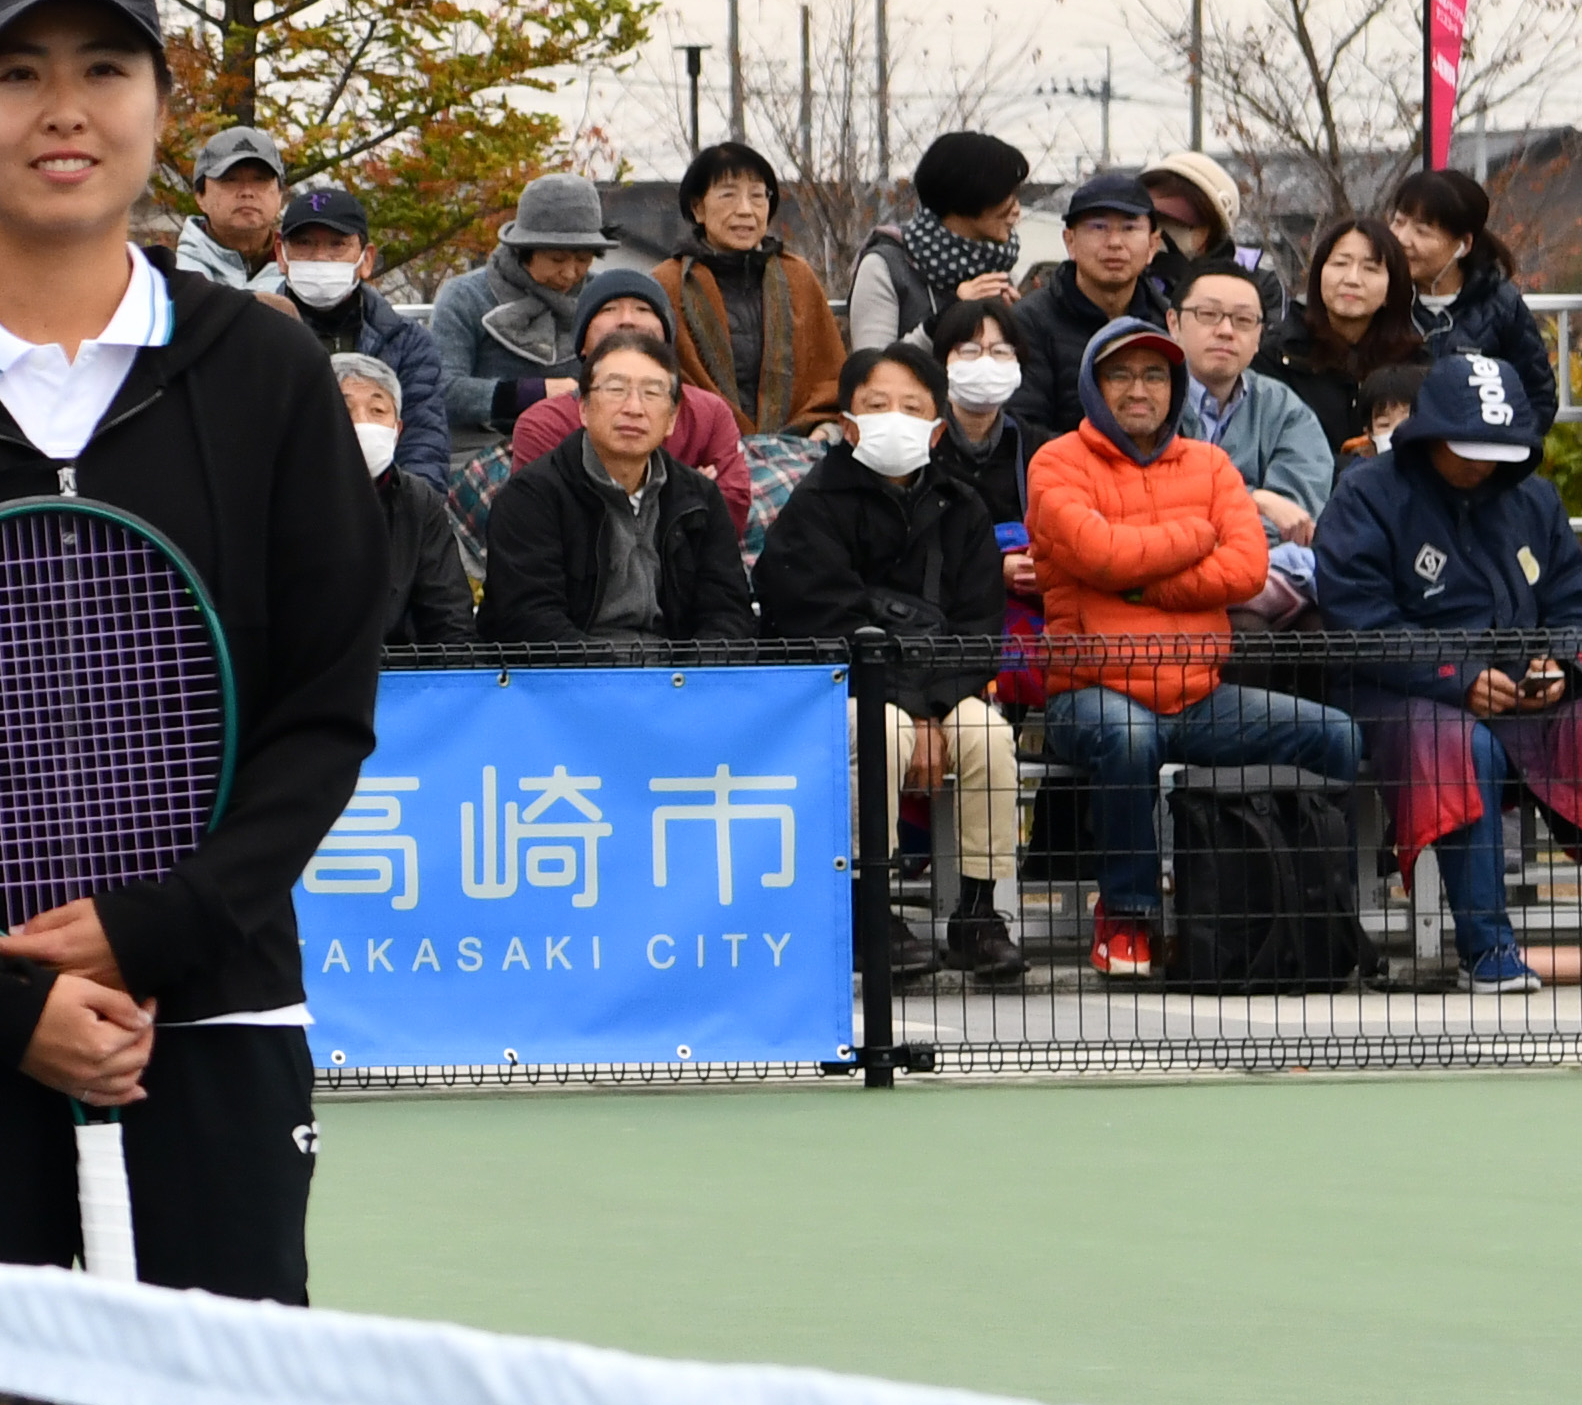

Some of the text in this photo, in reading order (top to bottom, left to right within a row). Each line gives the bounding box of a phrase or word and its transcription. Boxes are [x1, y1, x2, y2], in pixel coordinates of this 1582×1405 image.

[300, 763, 797, 910] 高崎市
[301, 932, 793, 974] AKASAKI CITY
